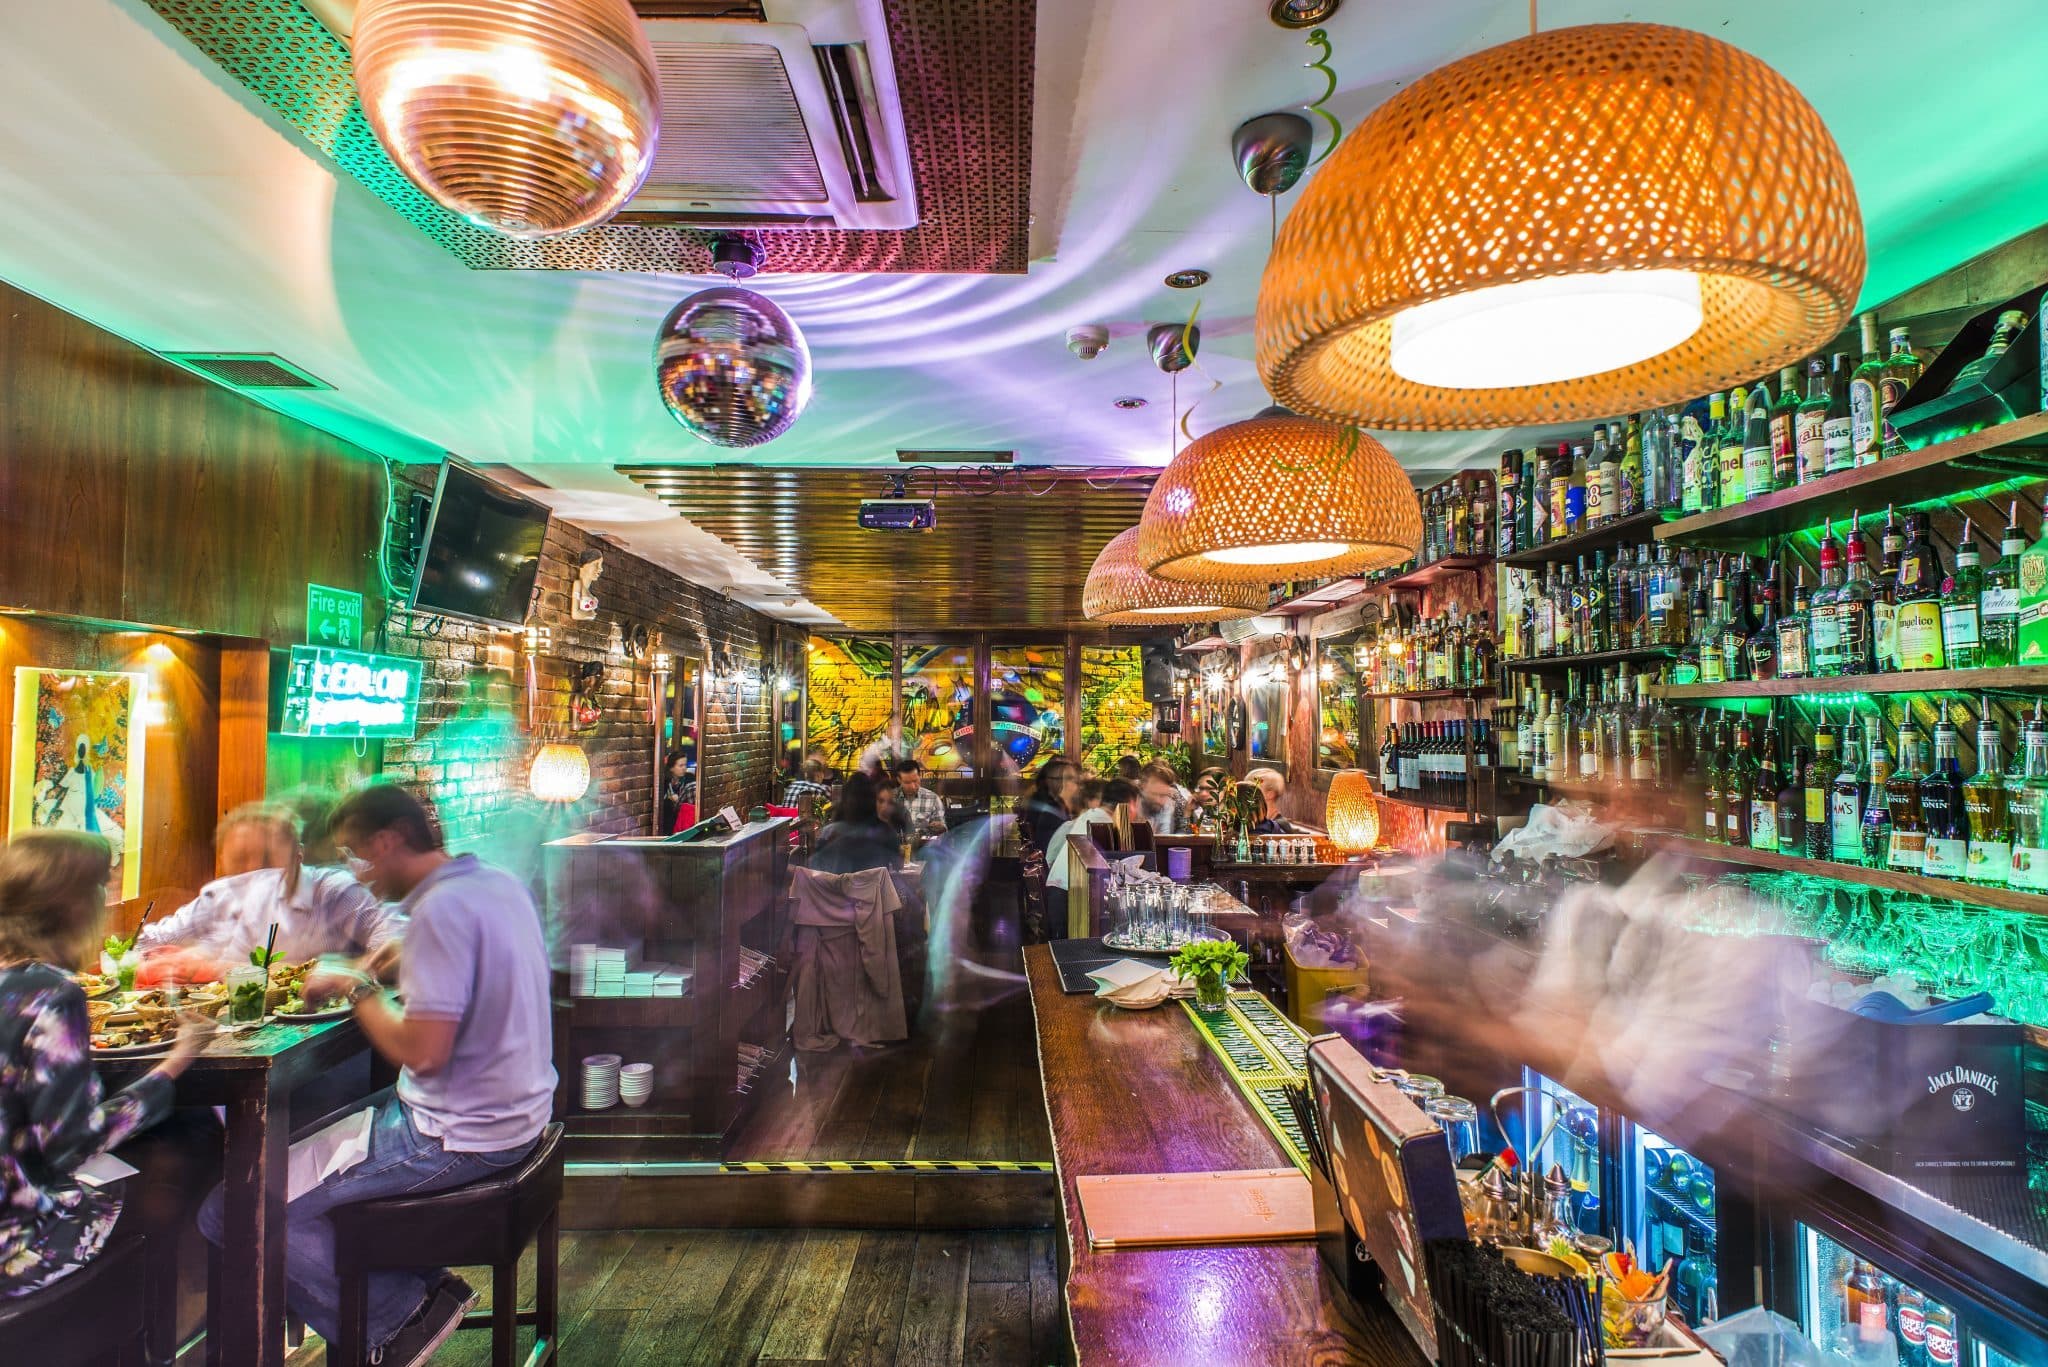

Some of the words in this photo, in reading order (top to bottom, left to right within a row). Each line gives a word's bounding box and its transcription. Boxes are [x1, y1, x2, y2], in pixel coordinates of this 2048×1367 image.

[310, 591, 337, 613] Fire
[338, 598, 360, 618] exit
[1866, 810, 1884, 818] OLS
[1928, 1071, 1955, 1094] JACK
[1955, 1066, 1999, 1094] DANIEL'S
